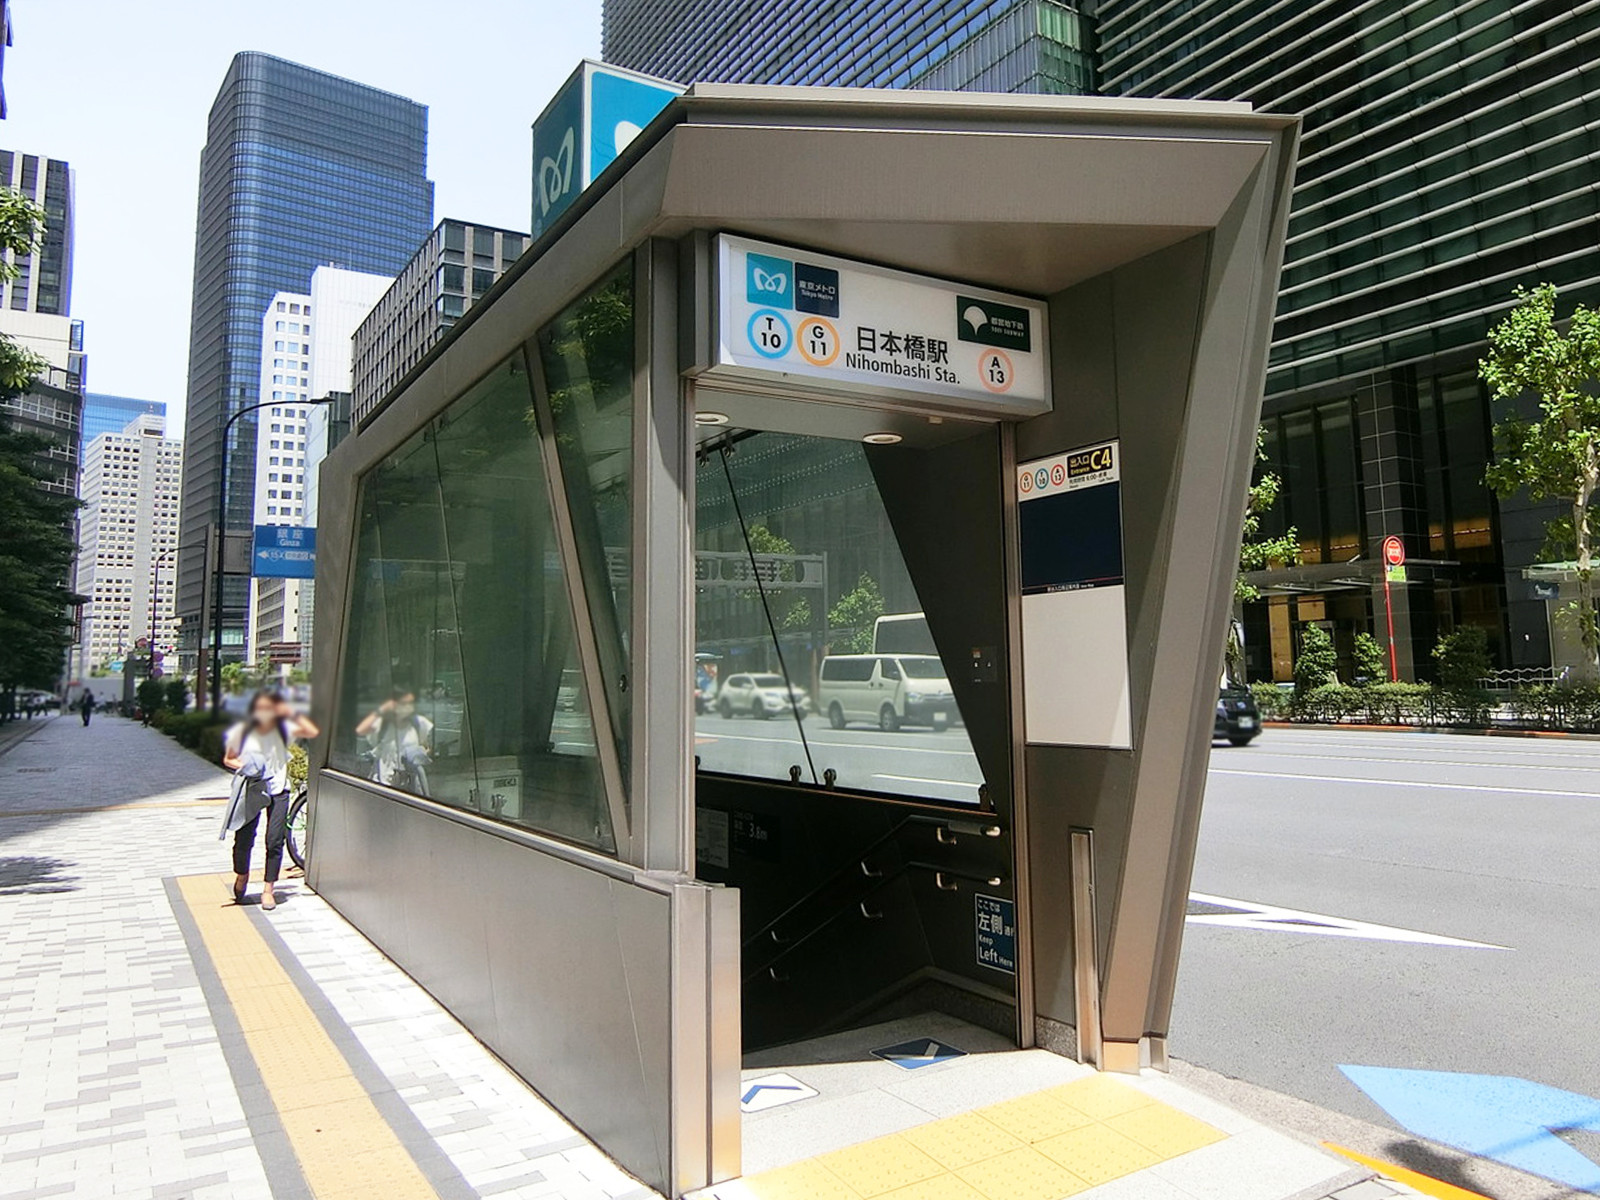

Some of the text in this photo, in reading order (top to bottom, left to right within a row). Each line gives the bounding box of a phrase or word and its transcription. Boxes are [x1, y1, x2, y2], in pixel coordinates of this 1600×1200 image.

[799, 280, 835, 294] 東京メトロ
[766, 317, 774, 331] T
[812, 325, 825, 339] G
[760, 332, 781, 349] 10
[809, 340, 828, 356] 11
[857, 326, 949, 365] 日本橋駅
[845, 352, 961, 385] Nihombashi Sta.
[990, 356, 1000, 369] A
[988, 368, 1005, 384] 13
[1069, 448, 1111, 471] 出入口 C4
[279, 539, 300, 547] Ginza
[978, 899, 1001, 912] ここでは
[979, 934, 994, 945] Keep
[979, 946, 1013, 967] Left Here
